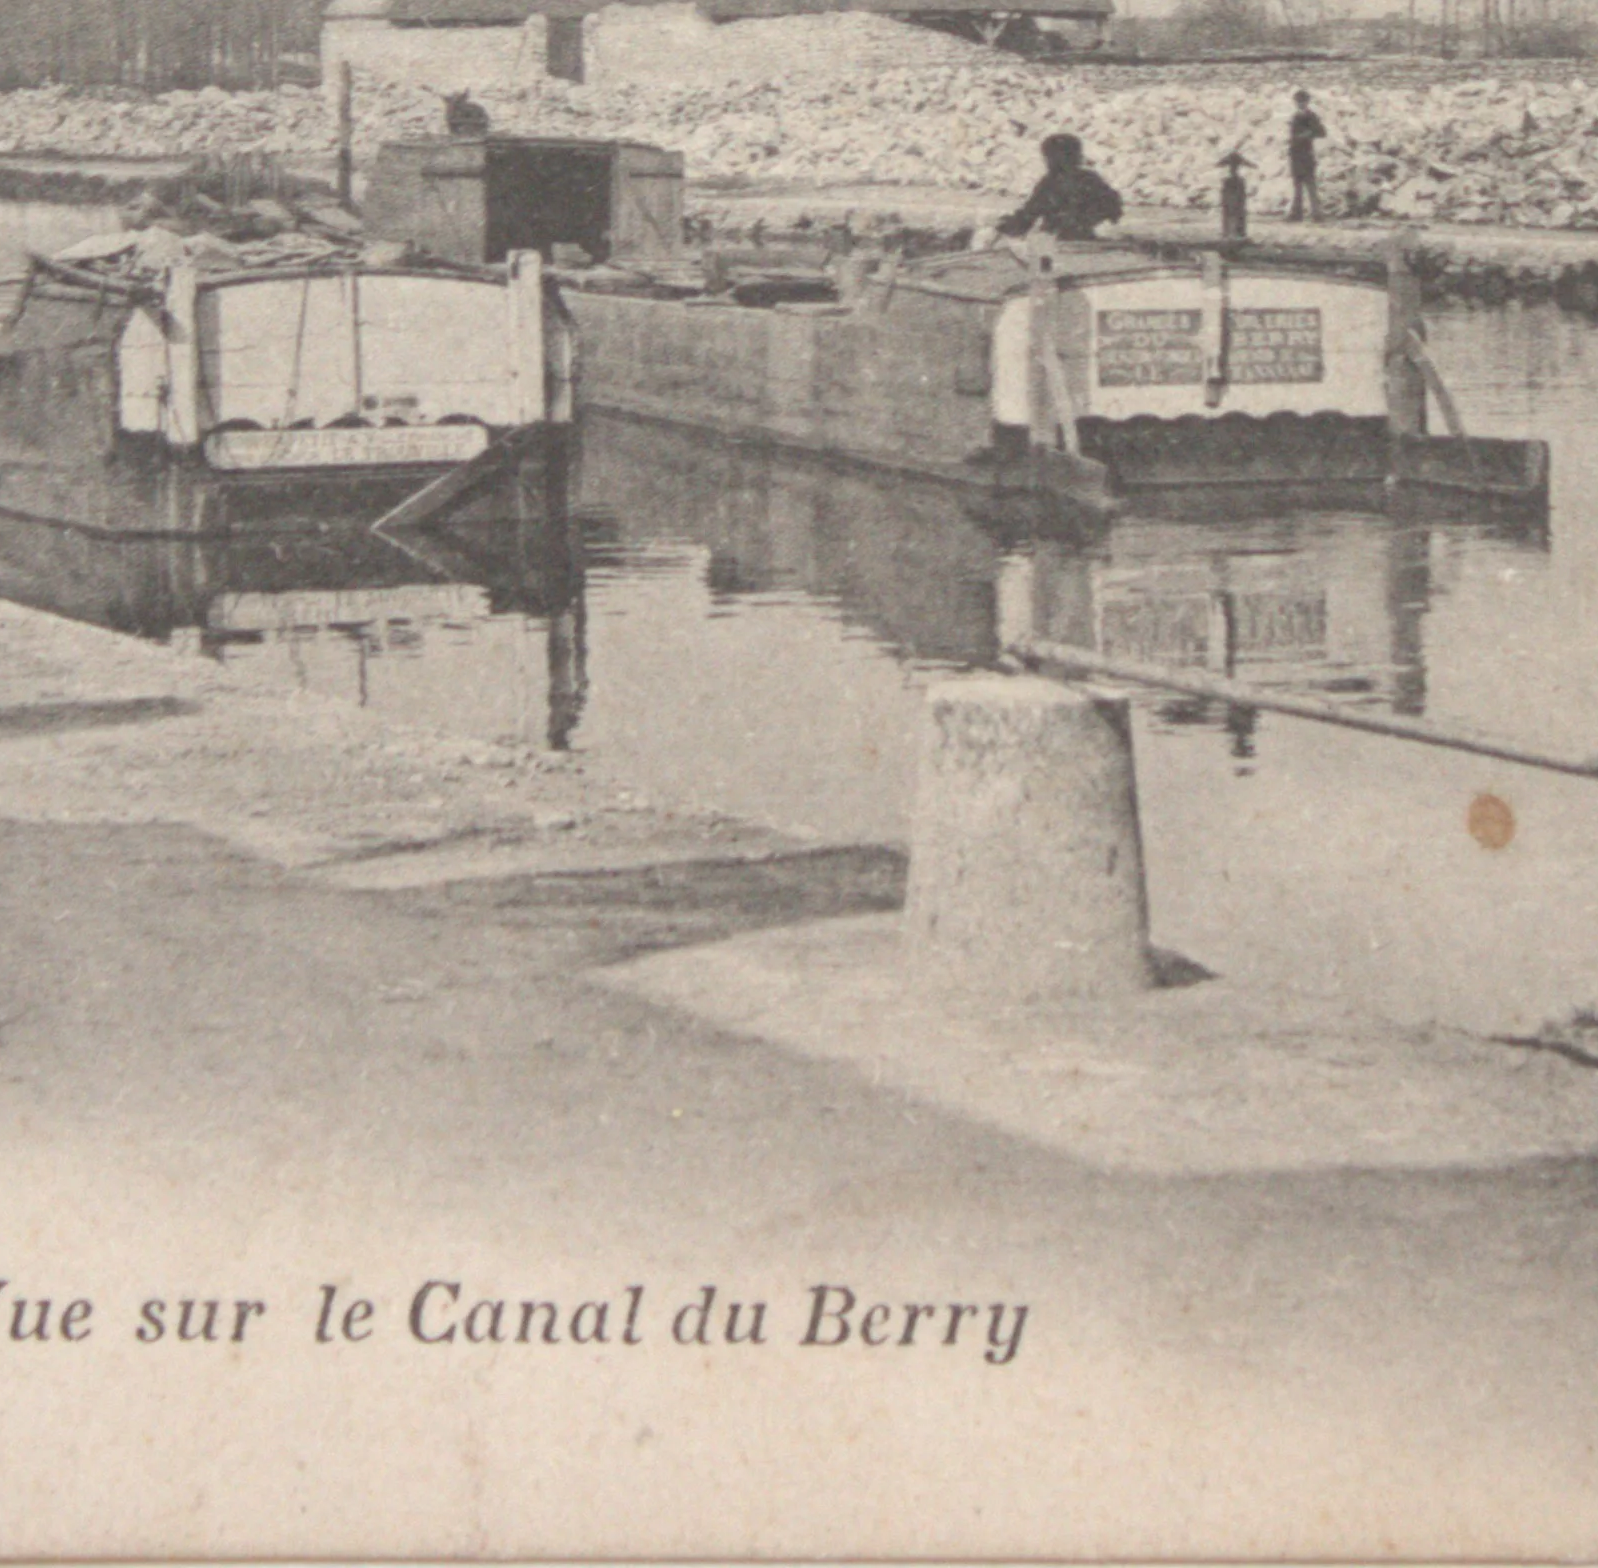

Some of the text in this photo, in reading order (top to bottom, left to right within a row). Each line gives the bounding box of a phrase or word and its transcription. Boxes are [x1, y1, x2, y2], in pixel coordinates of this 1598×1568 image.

[134, 1298, 268, 1345] sur
[314, 1282, 376, 1345] le
[407, 1279, 645, 1347] Canal
[670, 1284, 767, 1347] du
[798, 1283, 1030, 1367] Berry
